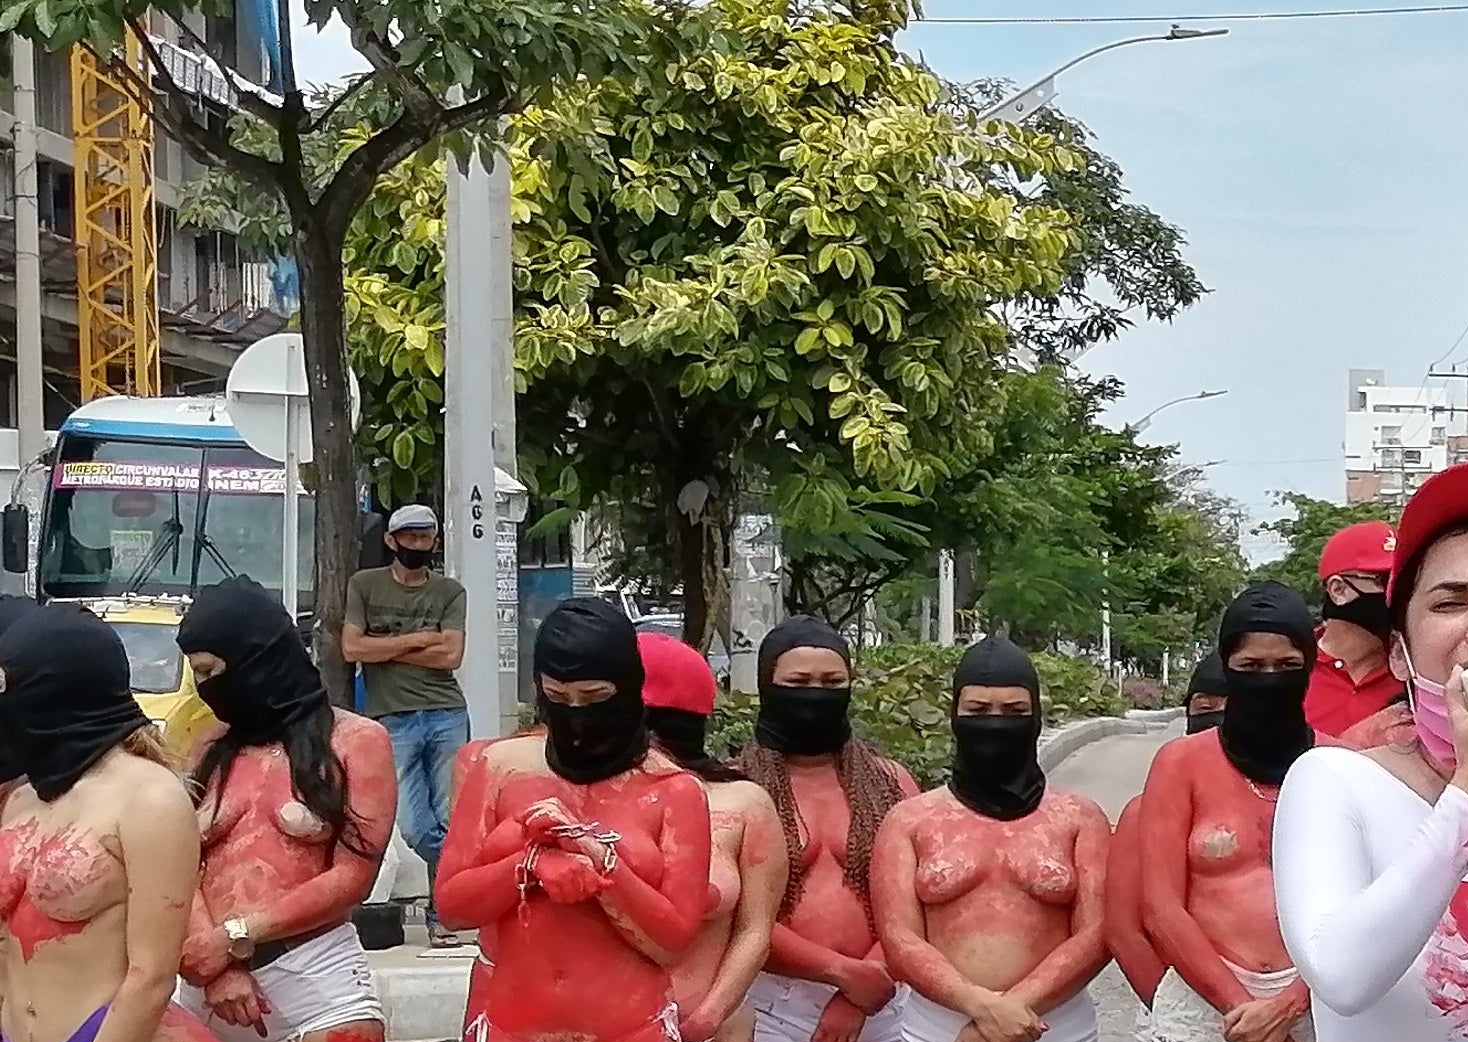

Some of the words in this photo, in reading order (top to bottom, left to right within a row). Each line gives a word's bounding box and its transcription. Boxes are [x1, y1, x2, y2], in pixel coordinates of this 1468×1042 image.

[63, 464, 113, 475] DIRECTO
[115, 465, 200, 477] CIRCUNVALAR
[60, 475, 144, 485] METROPARQUE
[145, 478, 200, 489] ESTADIO
[208, 480, 260, 491] INEM
